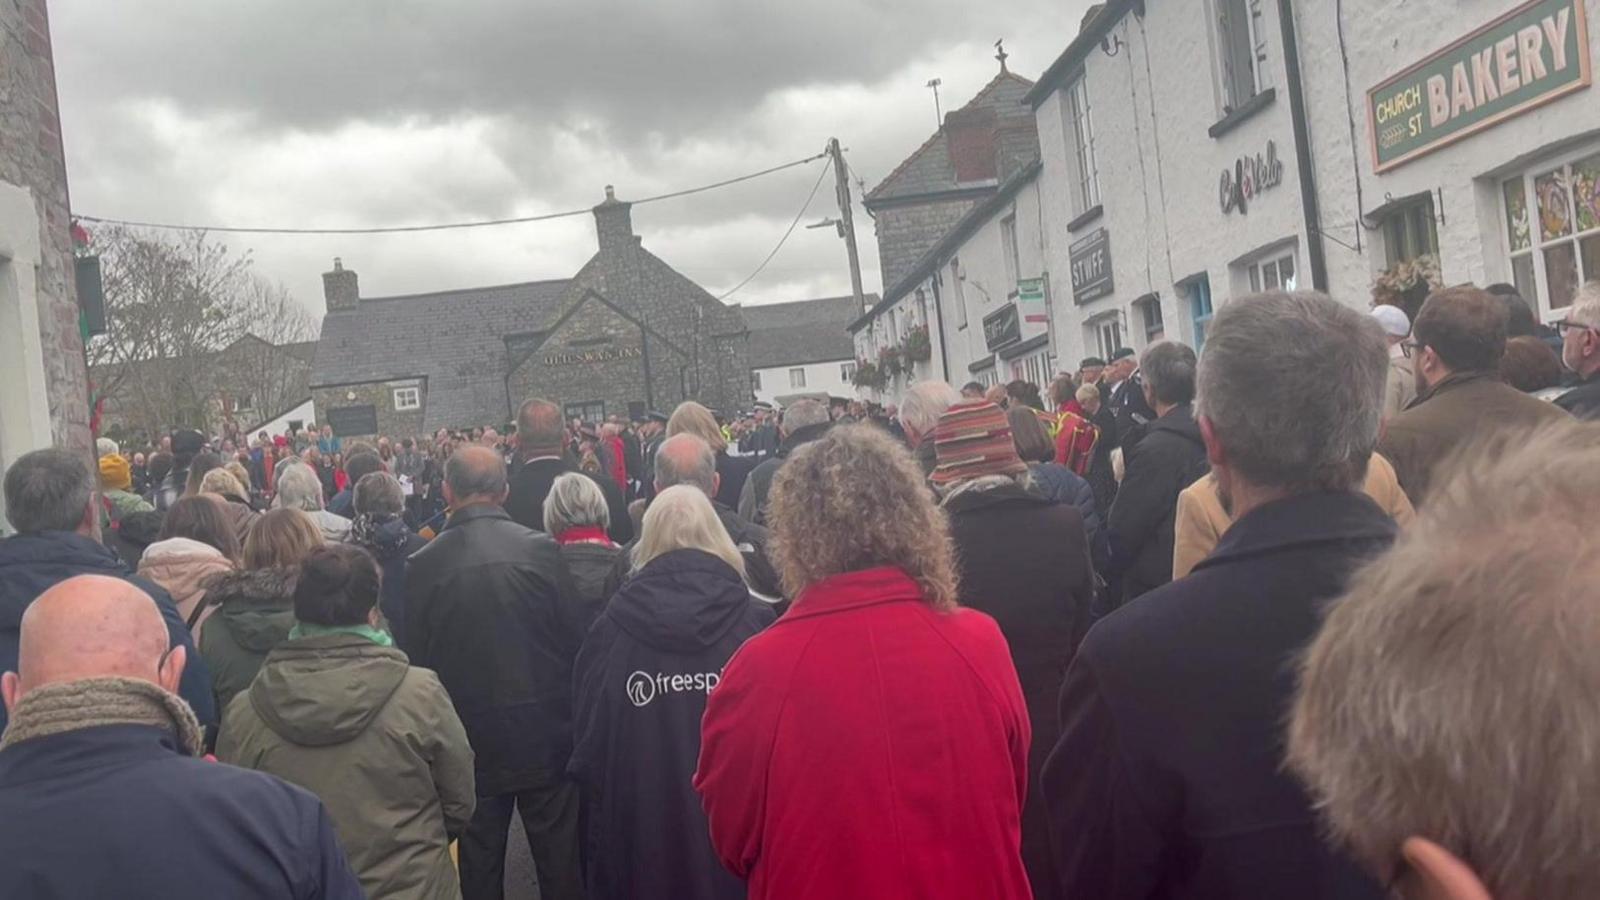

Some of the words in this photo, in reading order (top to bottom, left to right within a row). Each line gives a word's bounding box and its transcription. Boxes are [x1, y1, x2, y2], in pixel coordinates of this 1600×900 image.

[1427, 6, 1570, 128] BAKERY
[1376, 84, 1421, 124] CHURCH
[1408, 113, 1422, 137] ST
